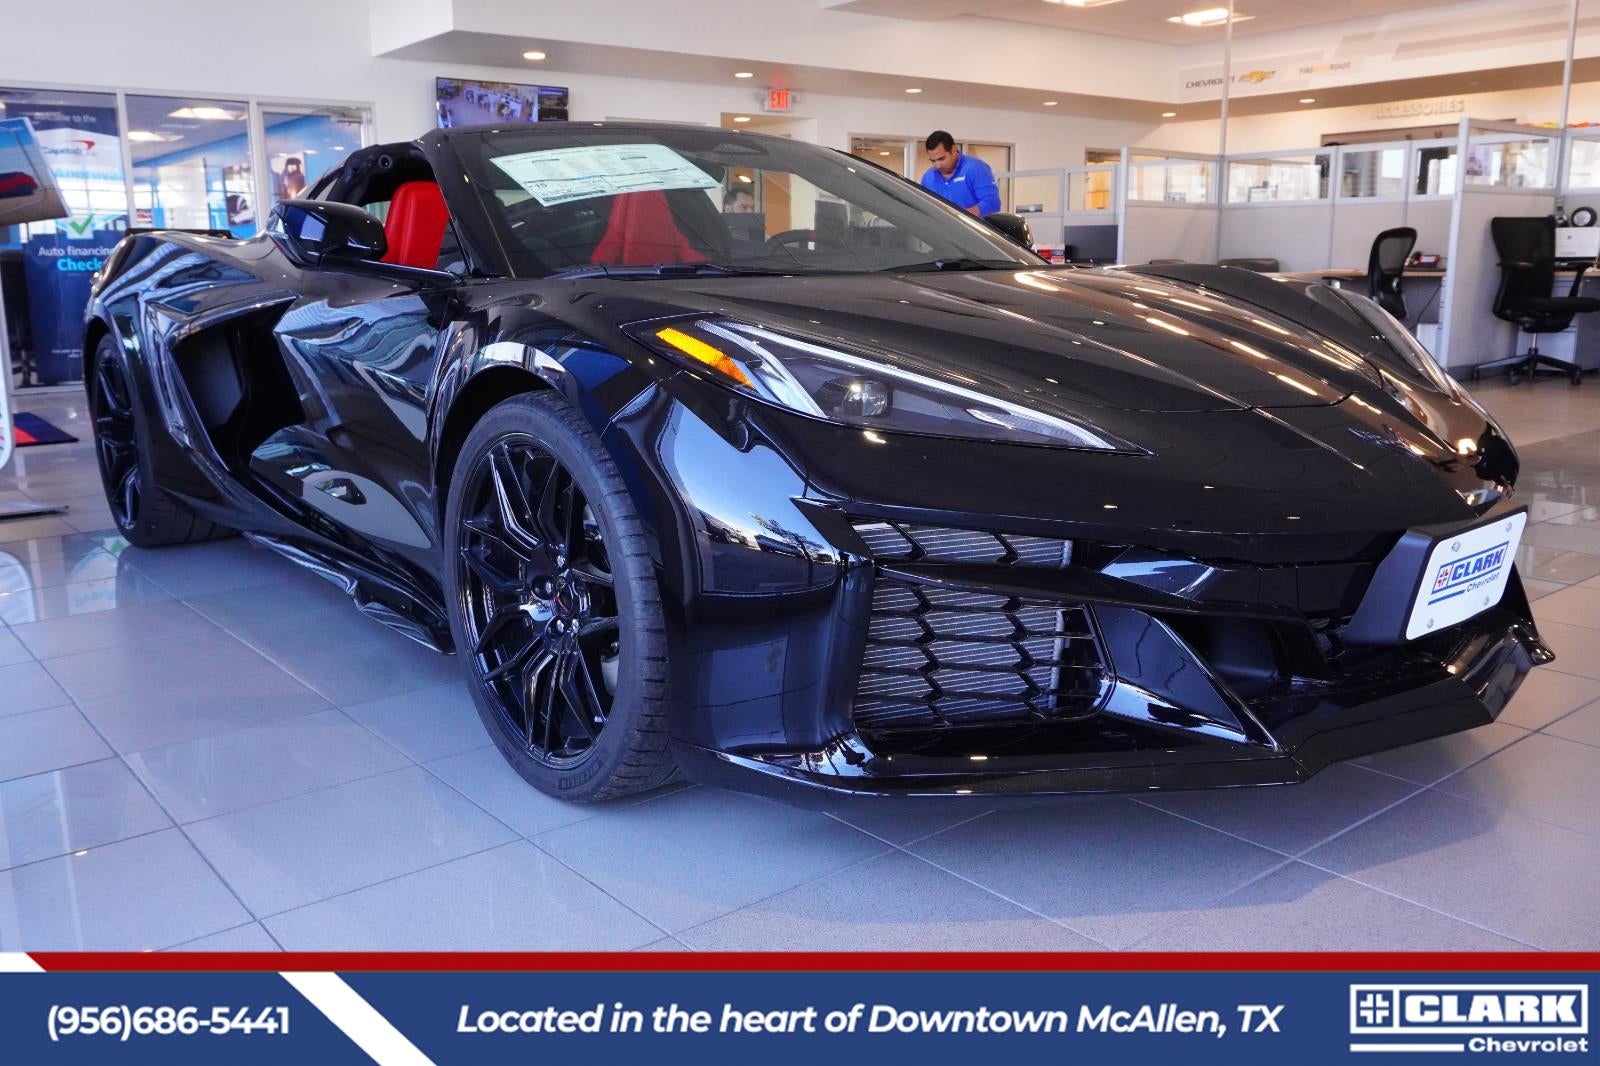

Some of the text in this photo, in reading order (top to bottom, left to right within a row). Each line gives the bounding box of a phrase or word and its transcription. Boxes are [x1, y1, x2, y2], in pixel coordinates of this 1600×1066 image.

[771, 90, 790, 108] EXIT
[38, 246, 65, 257] Auto
[1452, 549, 1503, 581] CLARK
[1466, 572, 1500, 592] Chevrolet
